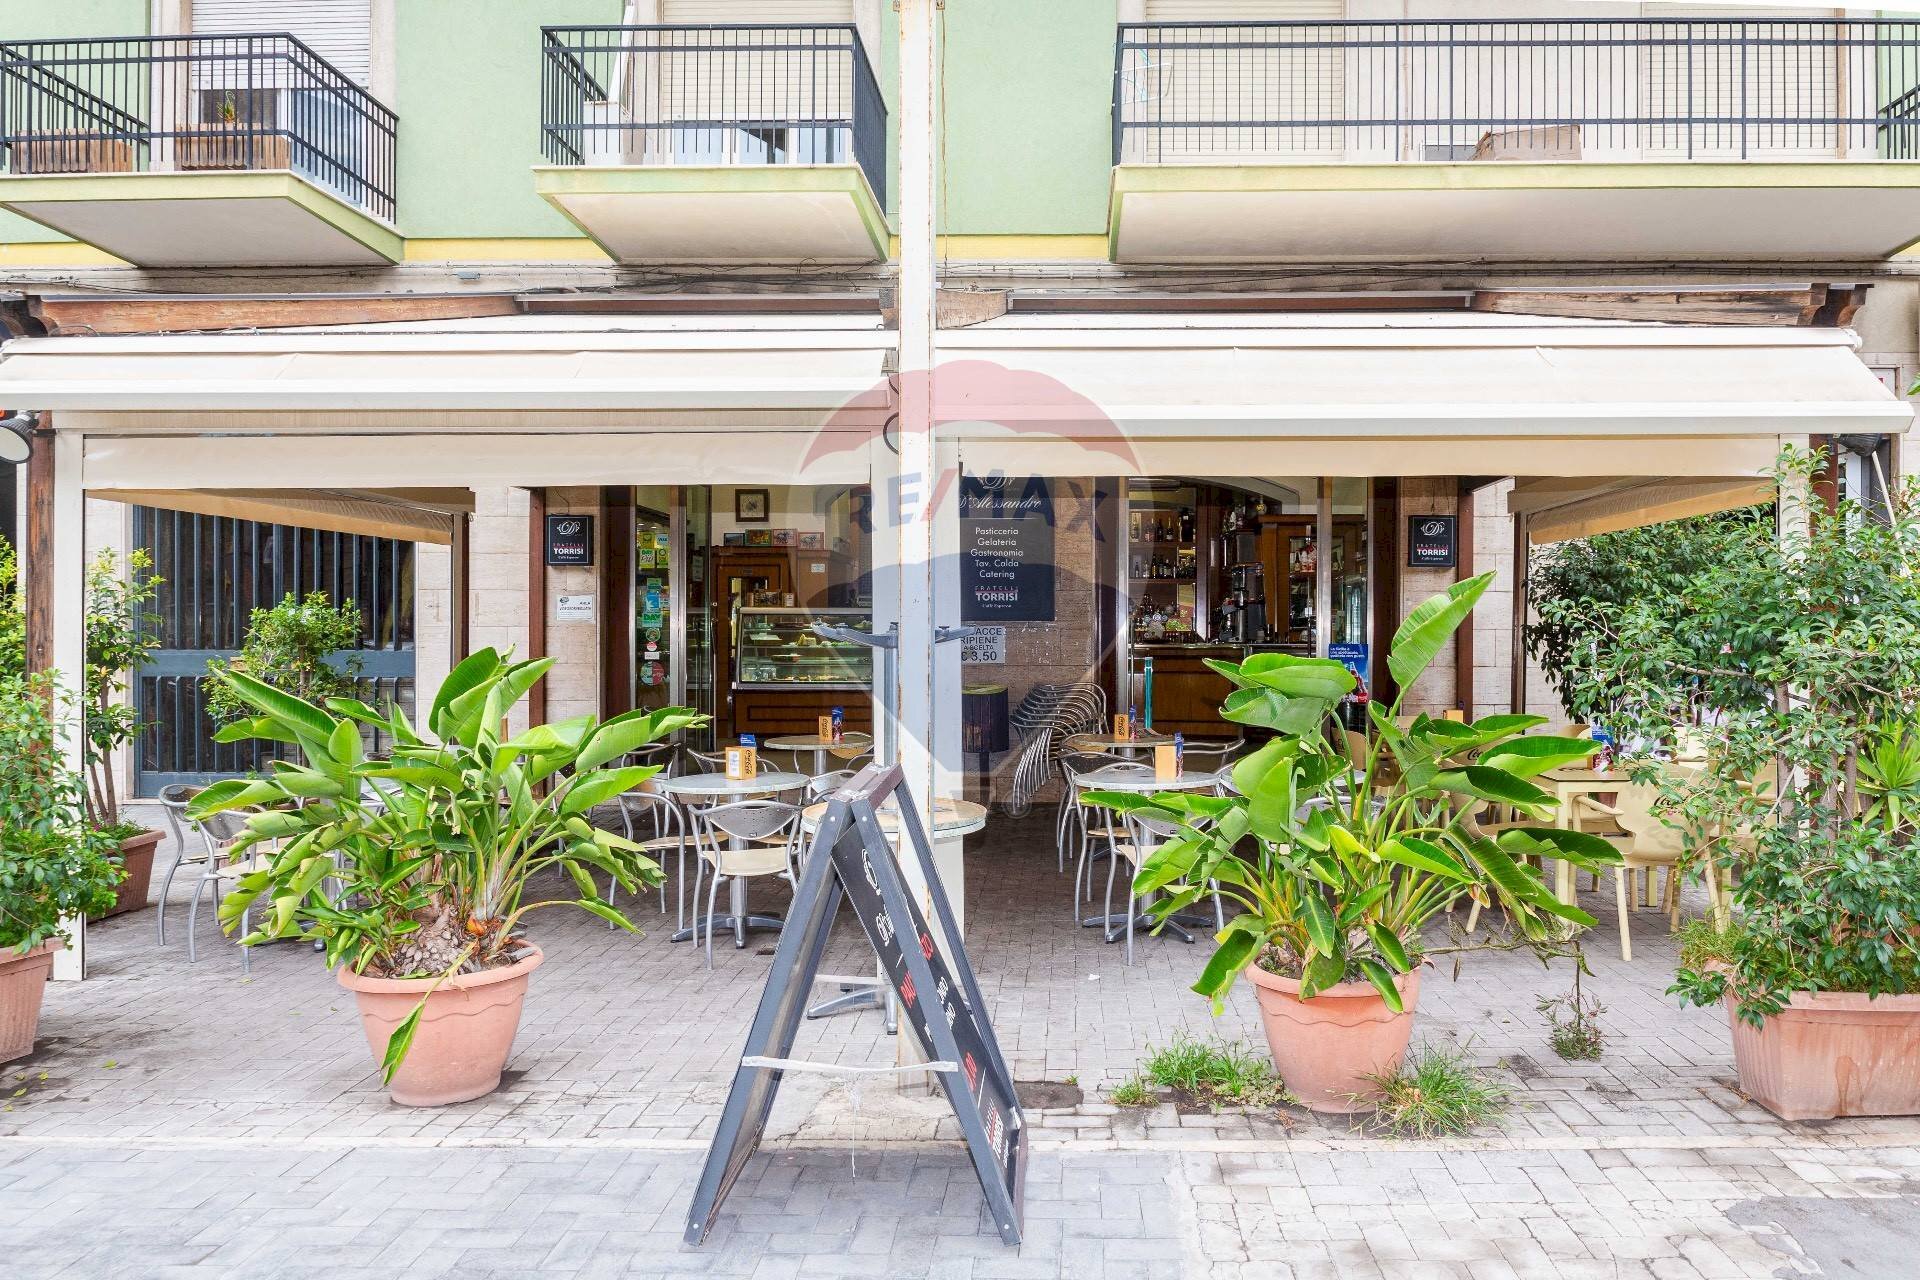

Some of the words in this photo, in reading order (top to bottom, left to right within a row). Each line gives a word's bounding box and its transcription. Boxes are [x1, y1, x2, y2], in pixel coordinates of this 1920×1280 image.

[975, 527, 1019, 535] Pasticceria
[977, 537, 1017, 546] Gelateria
[970, 548, 1024, 557] Gastronomia
[1417, 548, 1448, 556] TORRISI
[975, 559, 991, 567] Tav.
[994, 559, 1019, 567] Calda
[979, 569, 1015, 579] Catering
[975, 592, 1019, 601] TORRISI
[975, 627, 1003, 636] ACCE
[971, 651, 997, 662] 3,50
